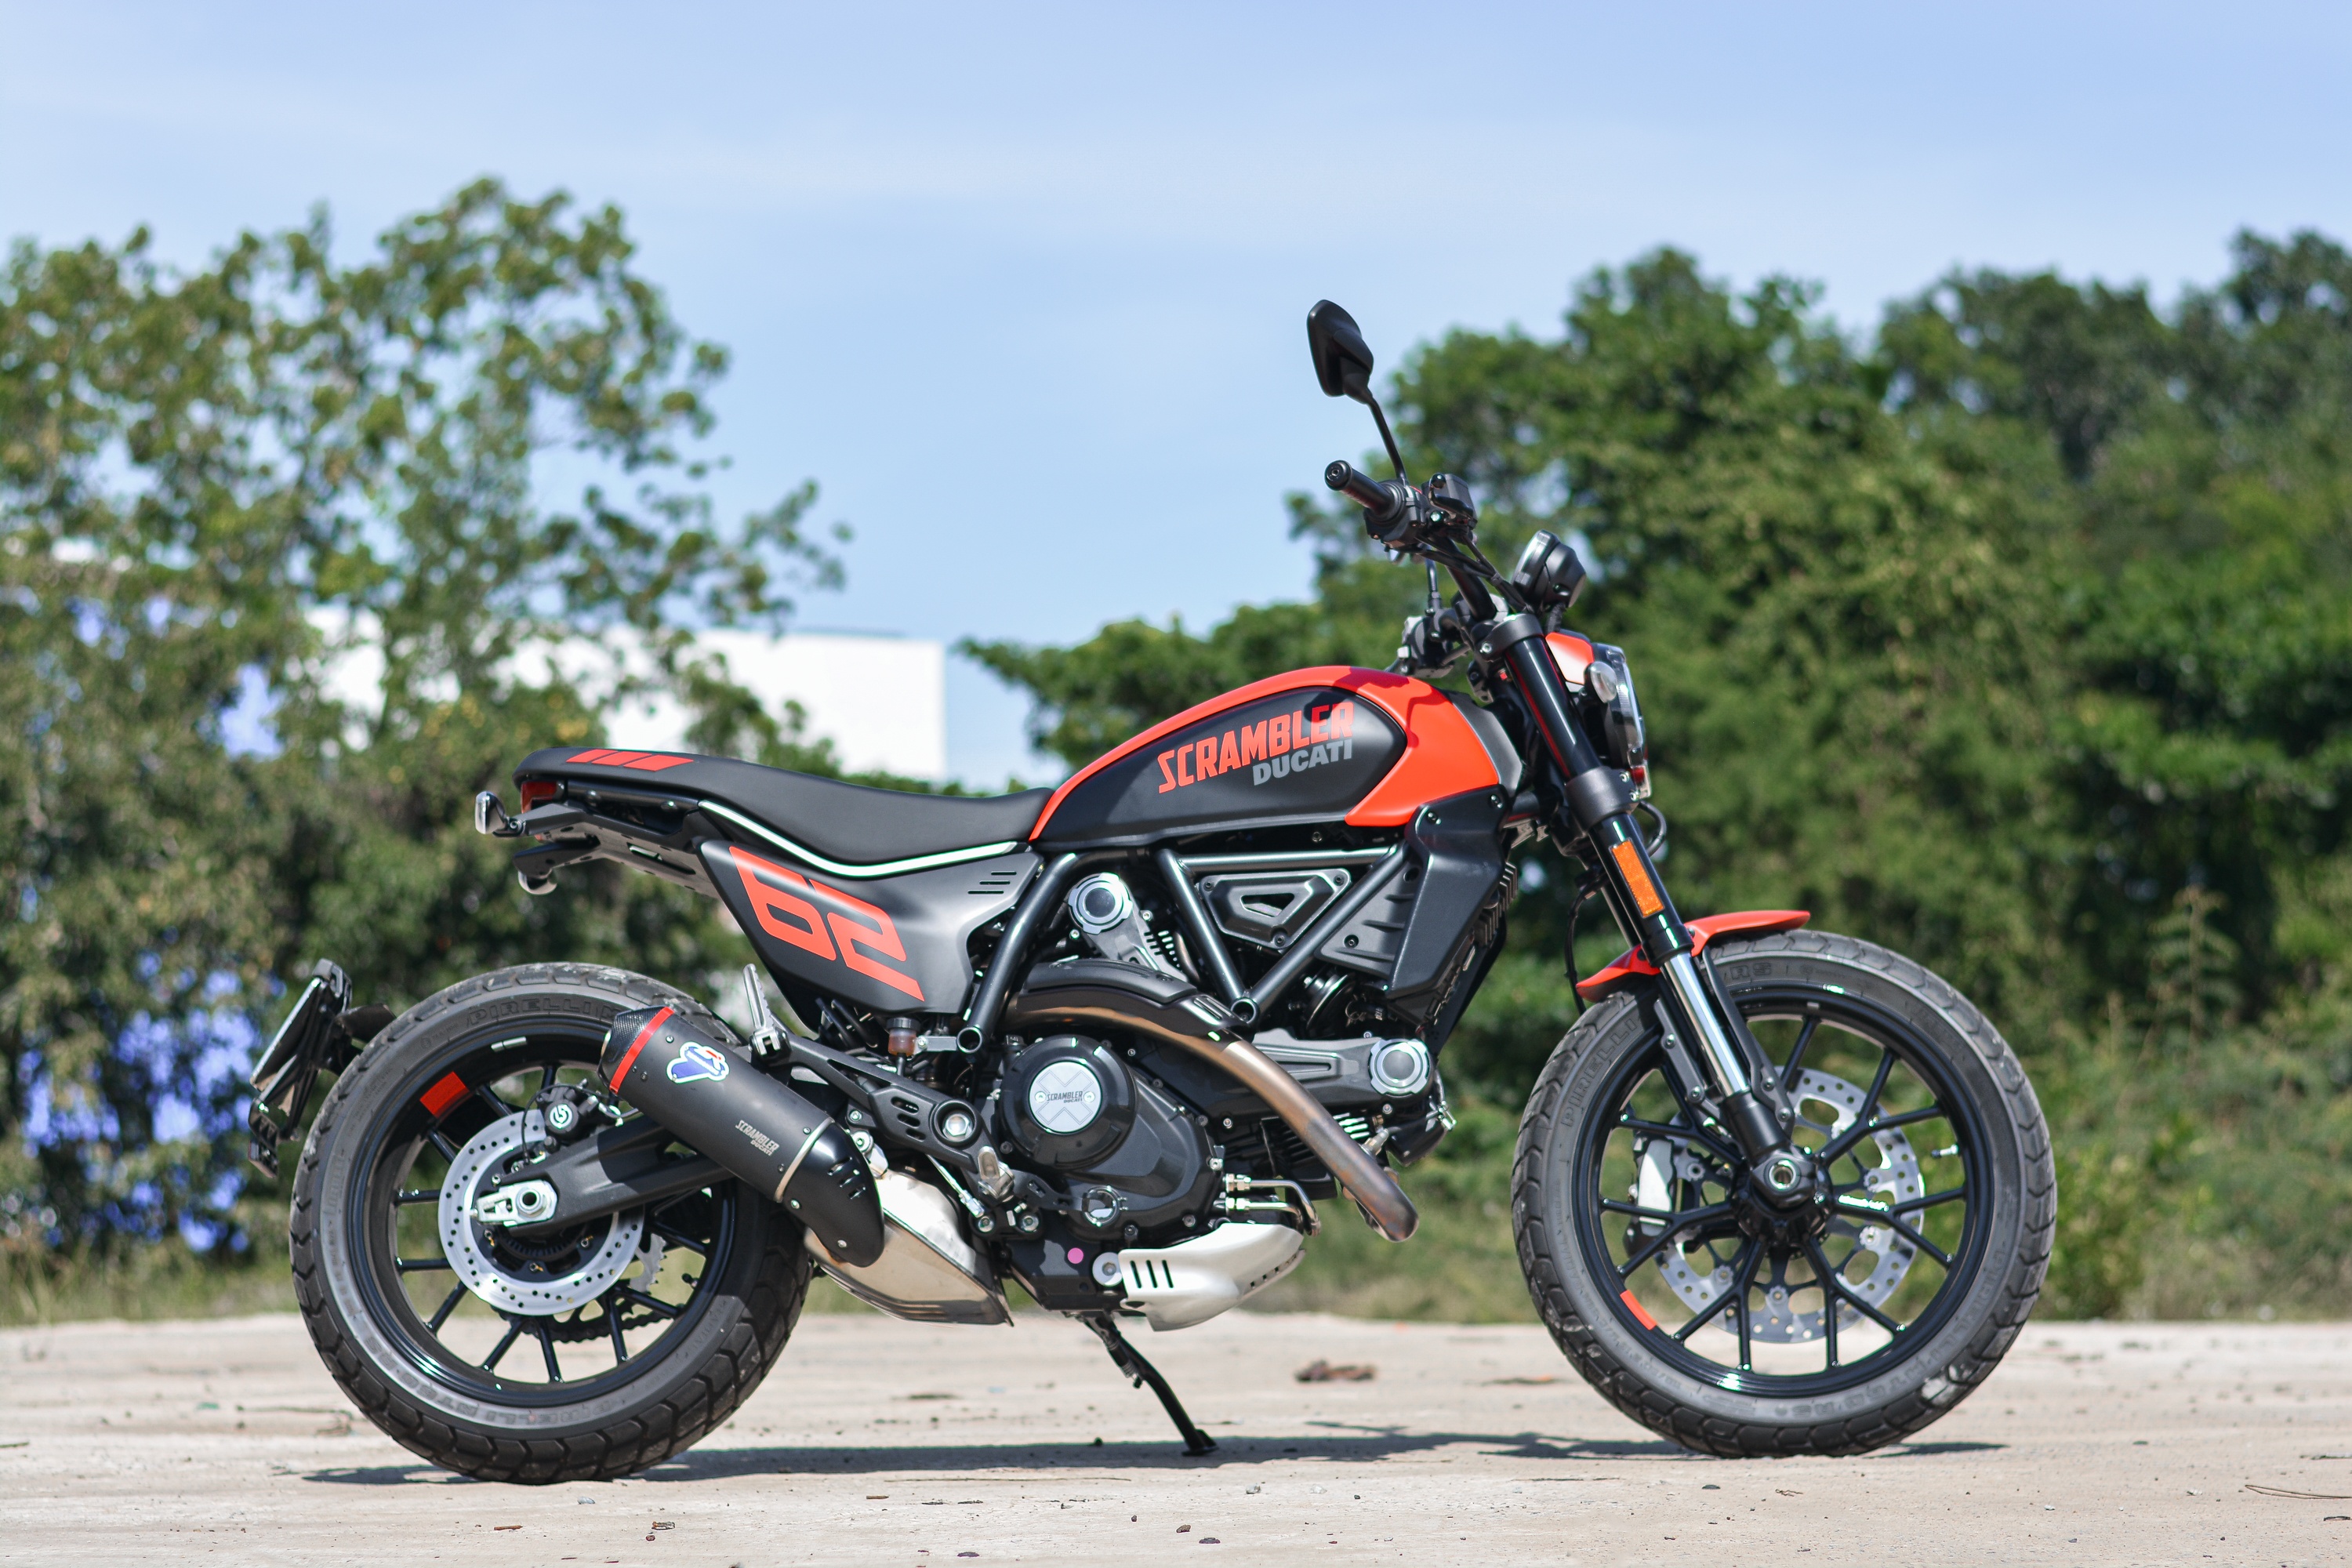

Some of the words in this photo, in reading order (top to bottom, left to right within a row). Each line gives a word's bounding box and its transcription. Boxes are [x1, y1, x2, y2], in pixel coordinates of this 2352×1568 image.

[1158, 702, 1355, 793] SCRAMBLER
[1254, 740, 1353, 786] DUCATI
[729, 846, 925, 1002] 62
[1728, 961, 1772, 980] RS
[465, 997, 591, 1026] PIRELLI
[1560, 1018, 1637, 1127] PIRELLI
[1047, 1091, 1083, 1102] SCRAMBLER
[735, 1120, 780, 1152] SCRAMBLER
[750, 1140, 772, 1156] DUCATI
